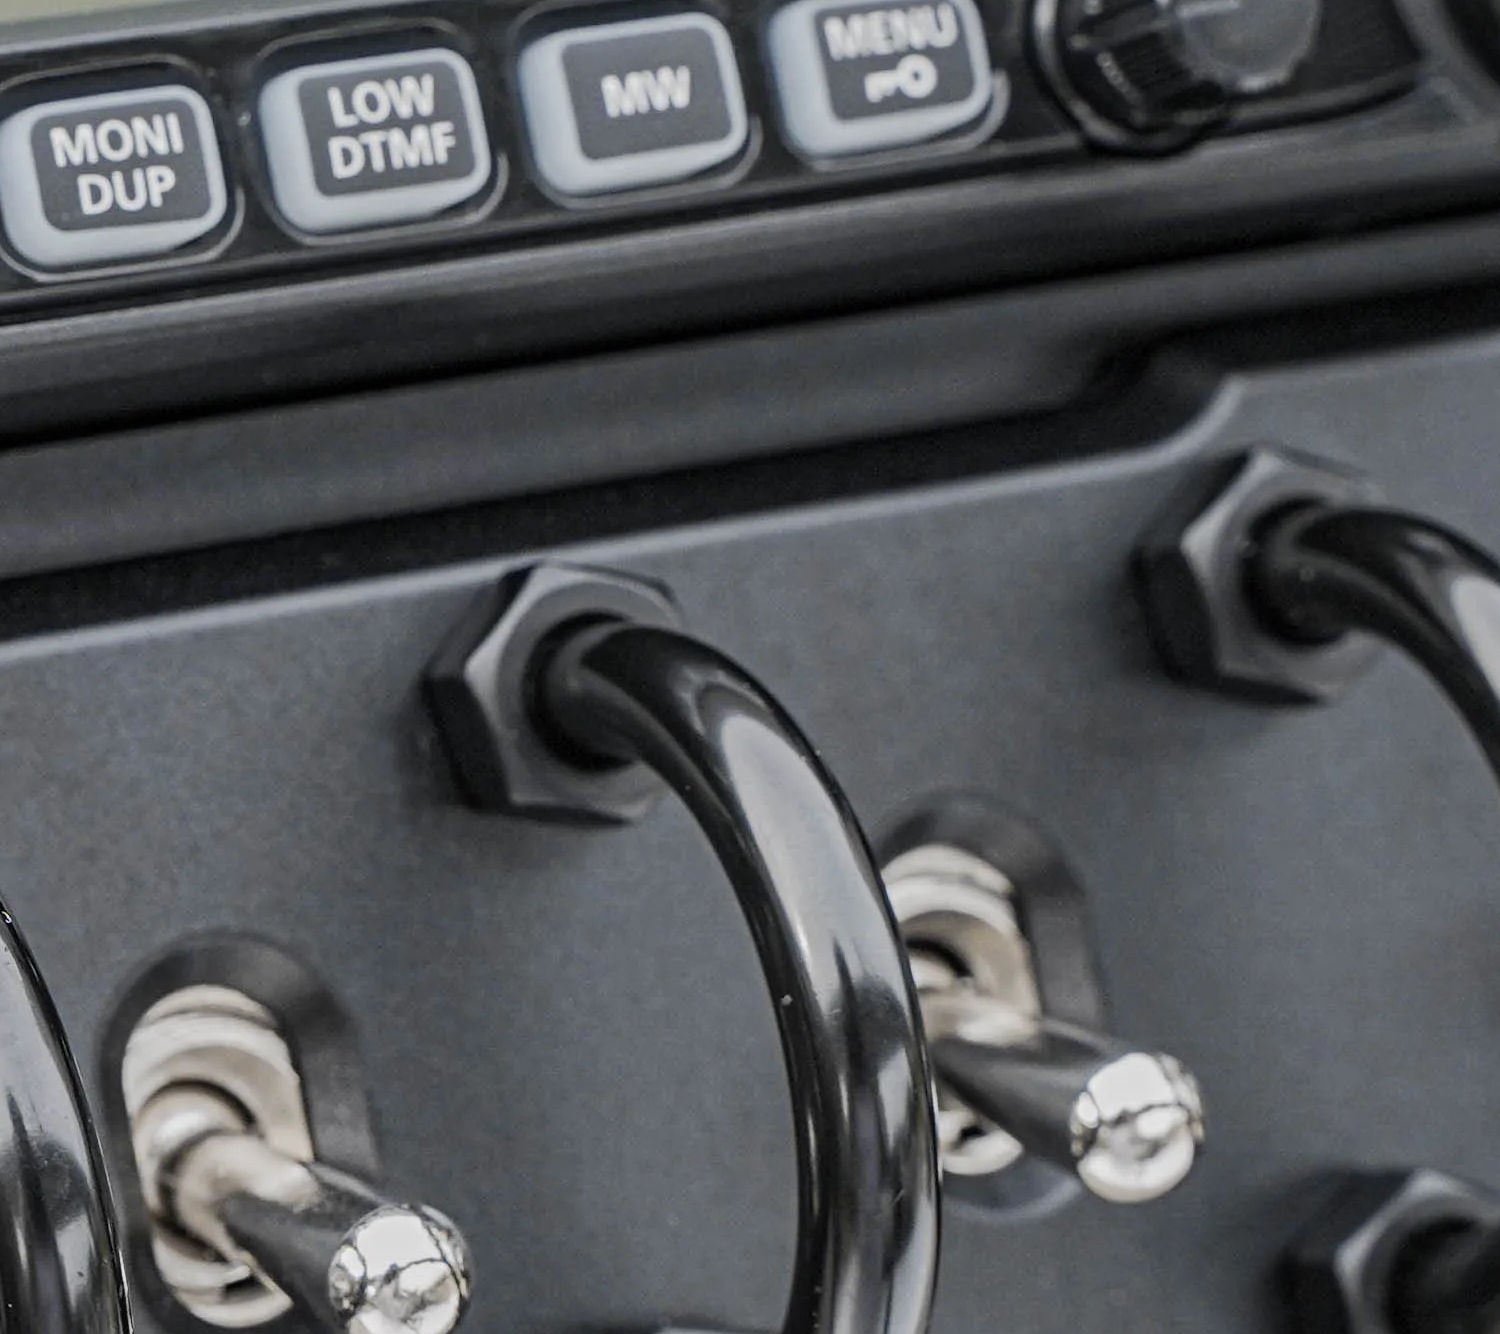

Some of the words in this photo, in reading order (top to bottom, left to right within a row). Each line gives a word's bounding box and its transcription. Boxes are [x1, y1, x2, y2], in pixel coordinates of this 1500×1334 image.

[824, 2, 958, 62] MENU
[327, 73, 434, 128] LOW
[601, 65, 690, 119] MW
[49, 112, 184, 168] MONI
[328, 120, 456, 179] DTMF
[77, 164, 176, 215] DUP
